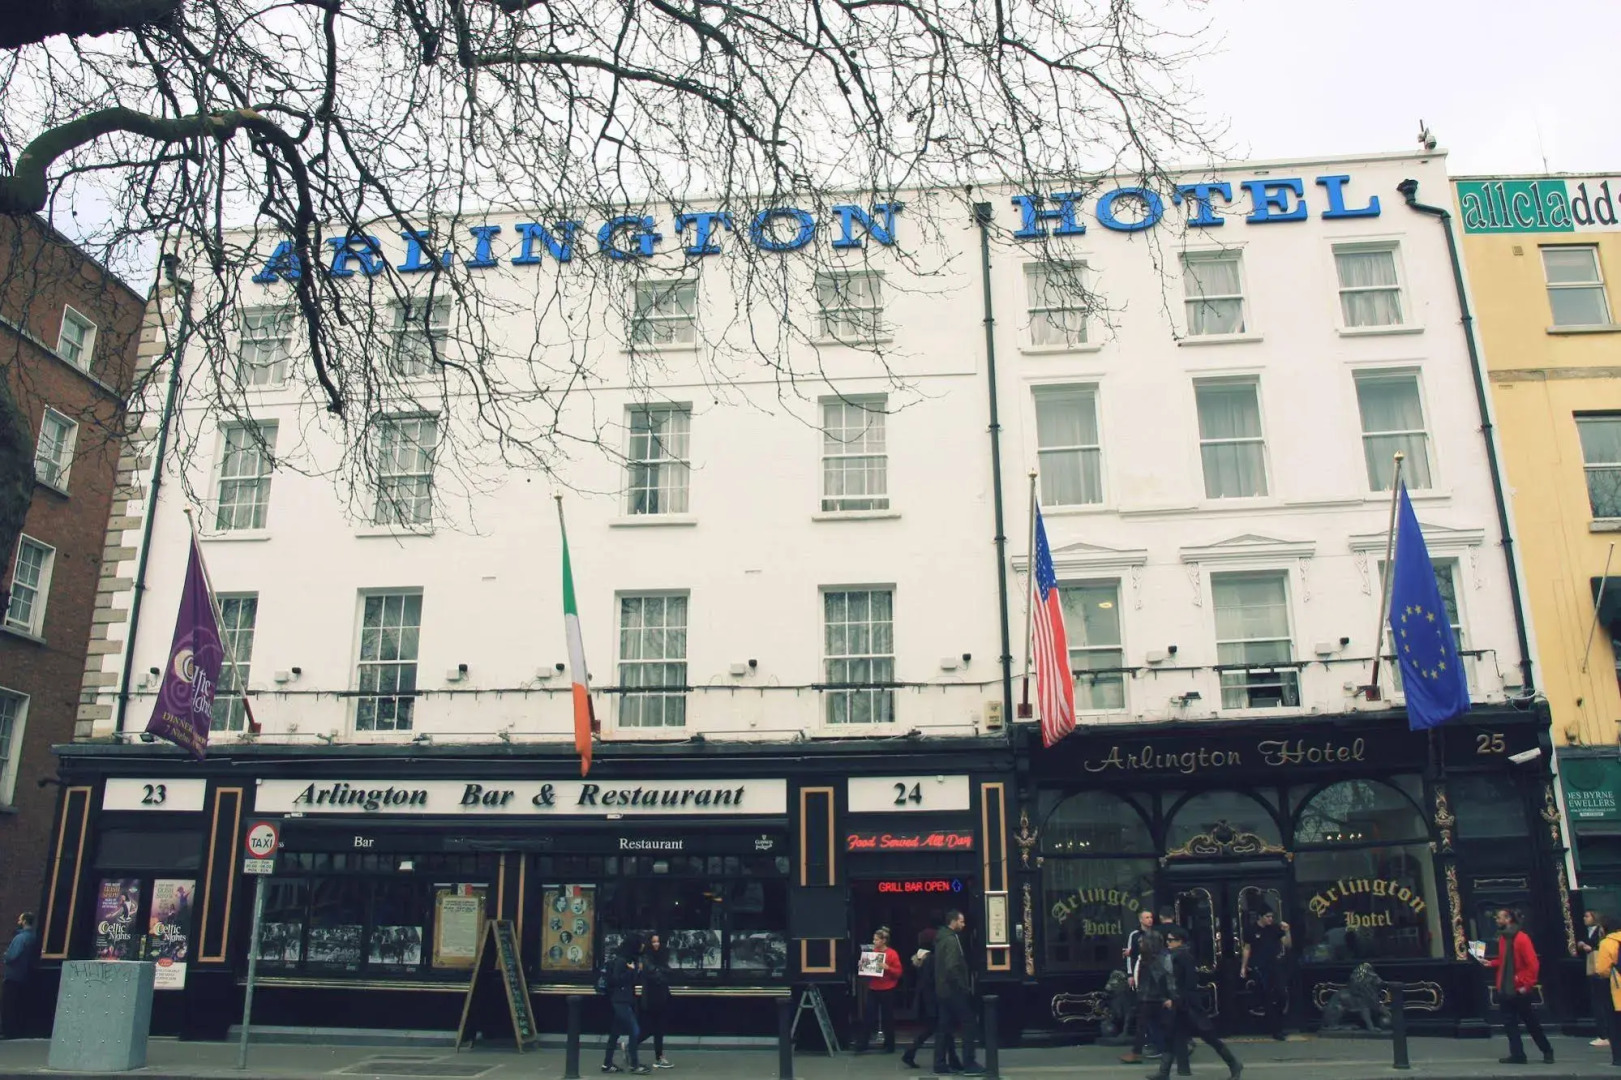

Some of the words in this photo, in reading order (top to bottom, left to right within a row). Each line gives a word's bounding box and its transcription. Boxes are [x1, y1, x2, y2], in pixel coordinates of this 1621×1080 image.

[1462, 179, 1621, 228] allcladd
[251, 200, 904, 283] ARLINGTON
[1011, 174, 1381, 240] HOTEL
[1476, 733, 1506, 753] 25
[1084, 746, 1242, 774] Arlington
[1258, 737, 1366, 766] Hotel
[141, 784, 167, 805] 23
[291, 782, 428, 811] Arlington
[459, 783, 515, 806] Bar
[531, 783, 556, 807] &
[576, 783, 745, 807] Restaurant
[893, 782, 923, 805] 24
[1583, 791, 1614, 800] BYRNE
[251, 837, 274, 849] TAXI
[354, 836, 375, 847] Bar
[619, 838, 684, 850] Restaurant
[847, 834, 877, 850] Food
[879, 834, 920, 848] Served
[920, 833, 944, 848] All
[945, 833, 973, 849] Day
[878, 882, 903, 893] GRILL
[904, 882, 923, 892] BAR
[924, 881, 950, 892] OPEN
[1051, 888, 1140, 925] Arlingto
[1308, 877, 1427, 918] Arlington
[98, 920, 126, 935] Celtic
[154, 921, 181, 936] Celtic
[1082, 919, 1123, 936] Hotel
[1343, 910, 1393, 932] Hotel
